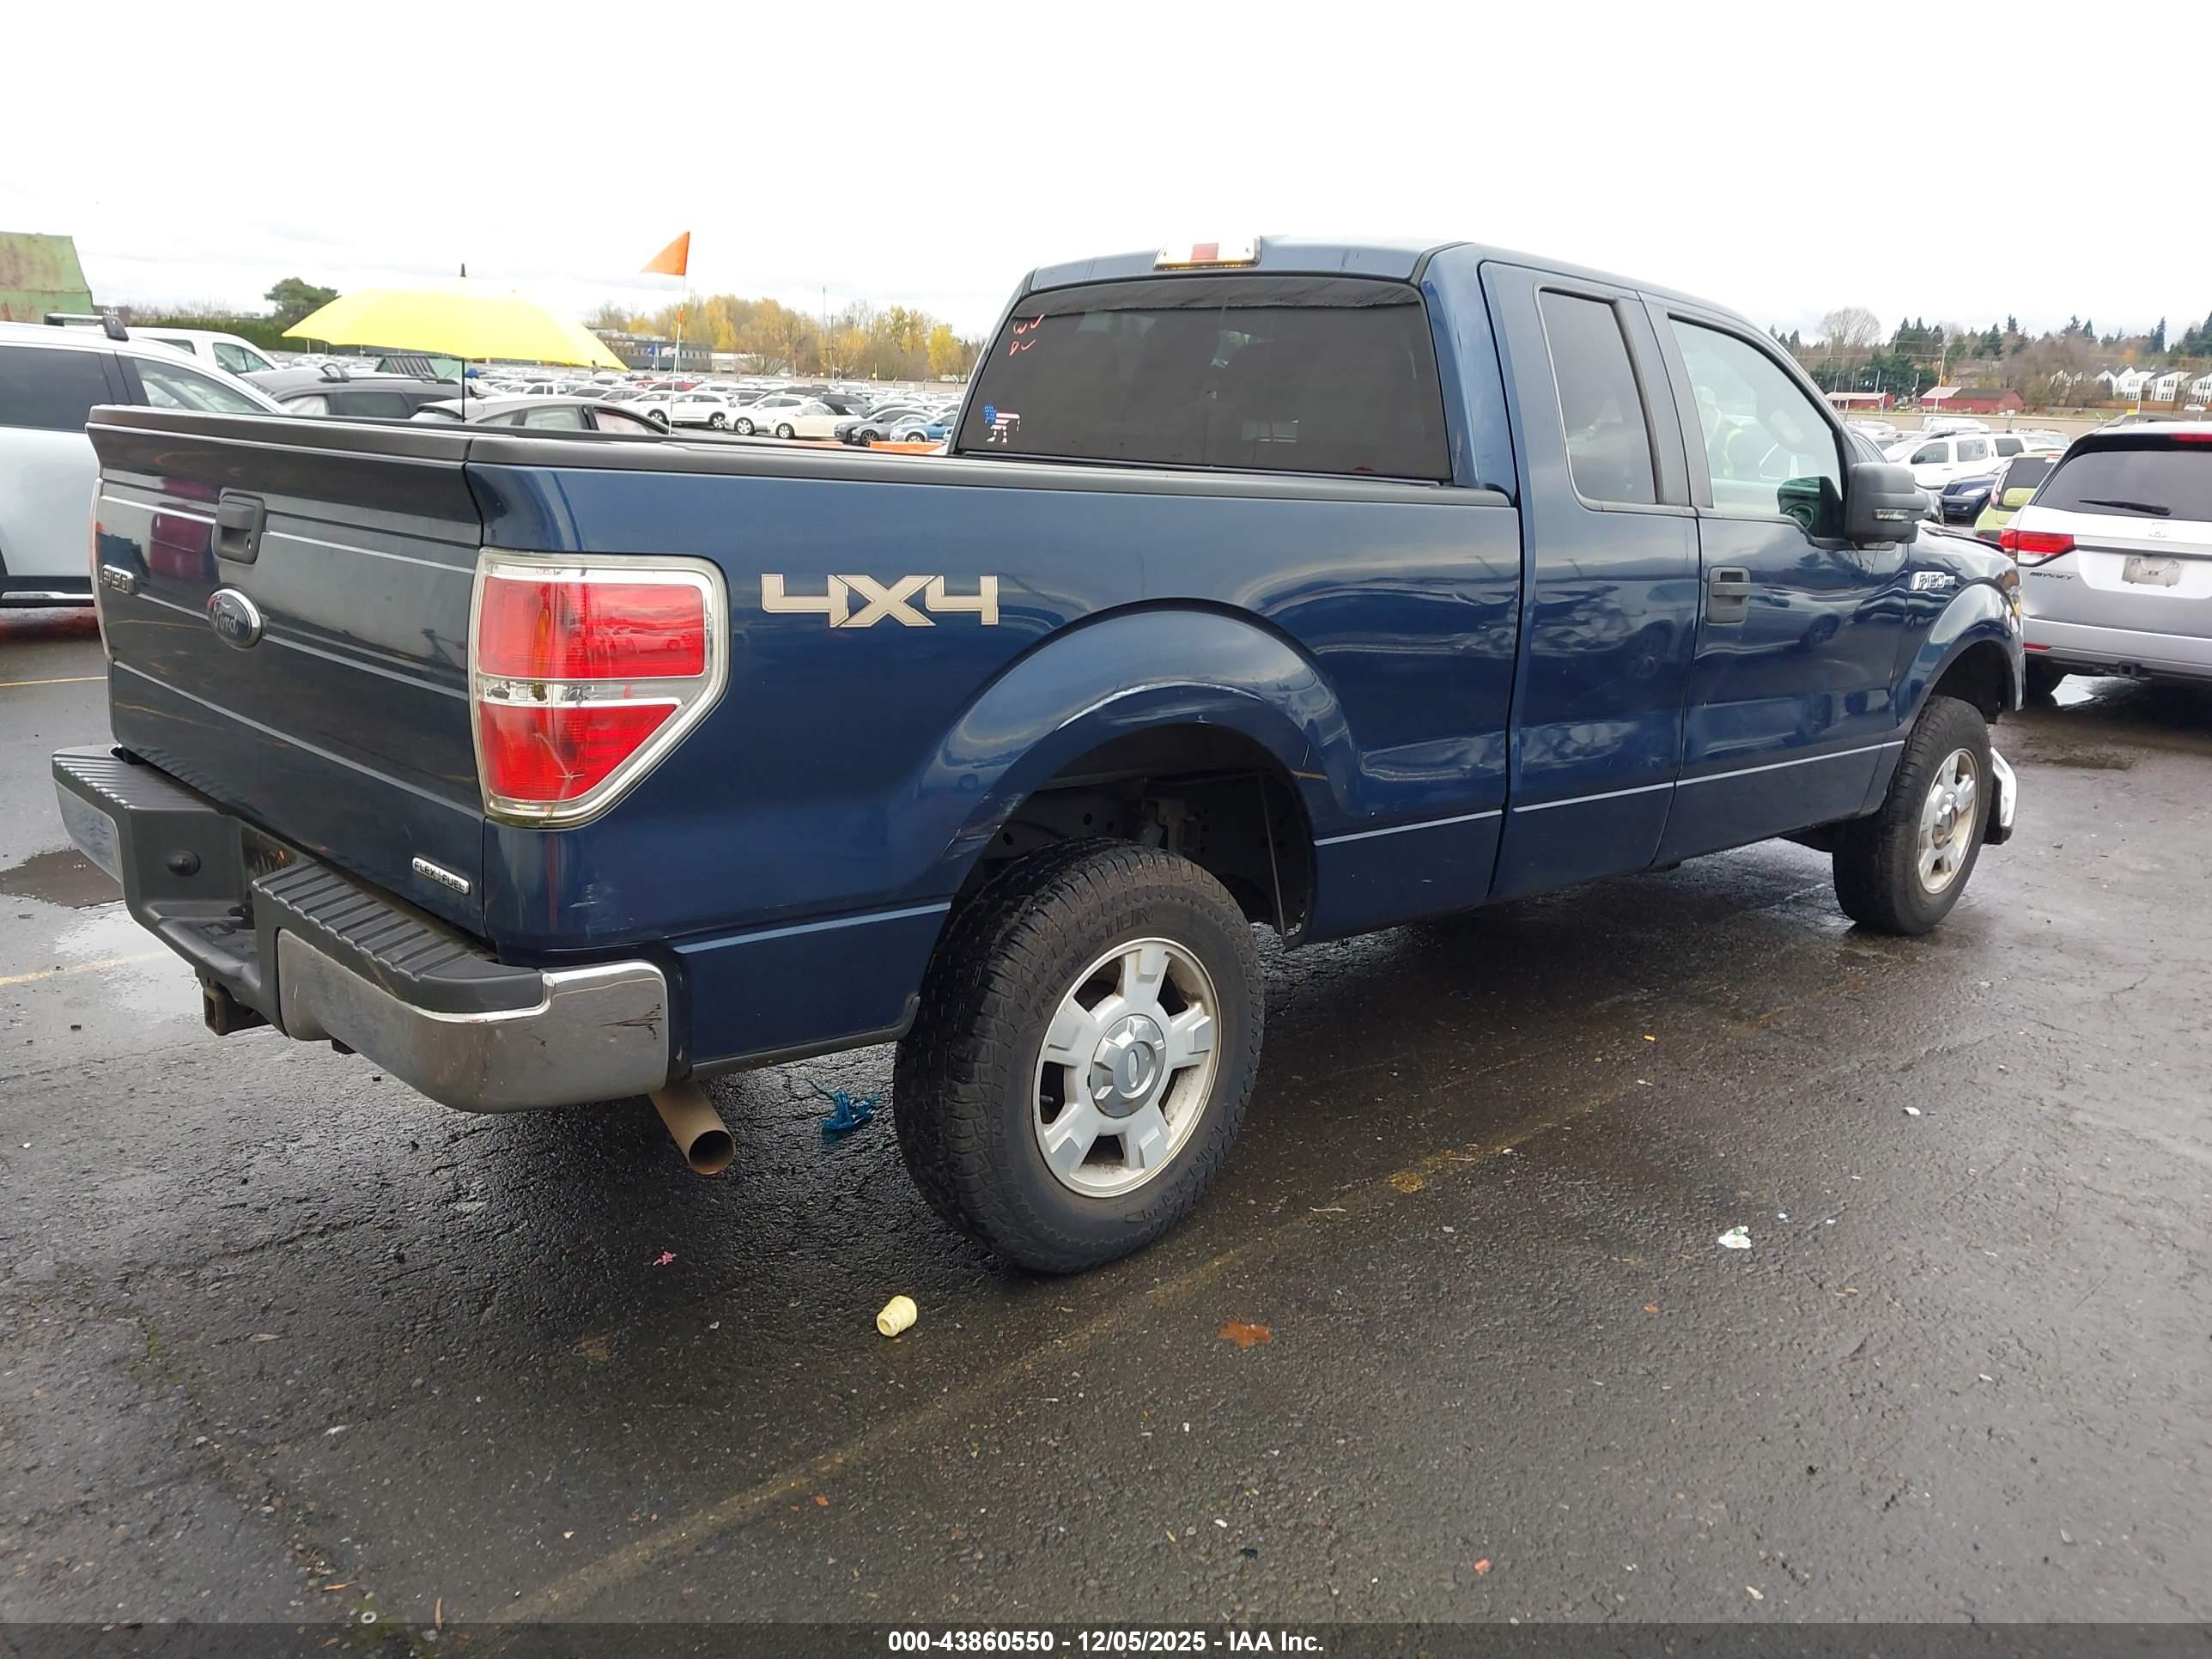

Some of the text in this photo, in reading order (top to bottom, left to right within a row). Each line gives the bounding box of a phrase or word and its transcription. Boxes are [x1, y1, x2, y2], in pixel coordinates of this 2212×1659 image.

[212, 594, 239, 635] Ford
[414, 860, 465, 891] FLEX FUEL
